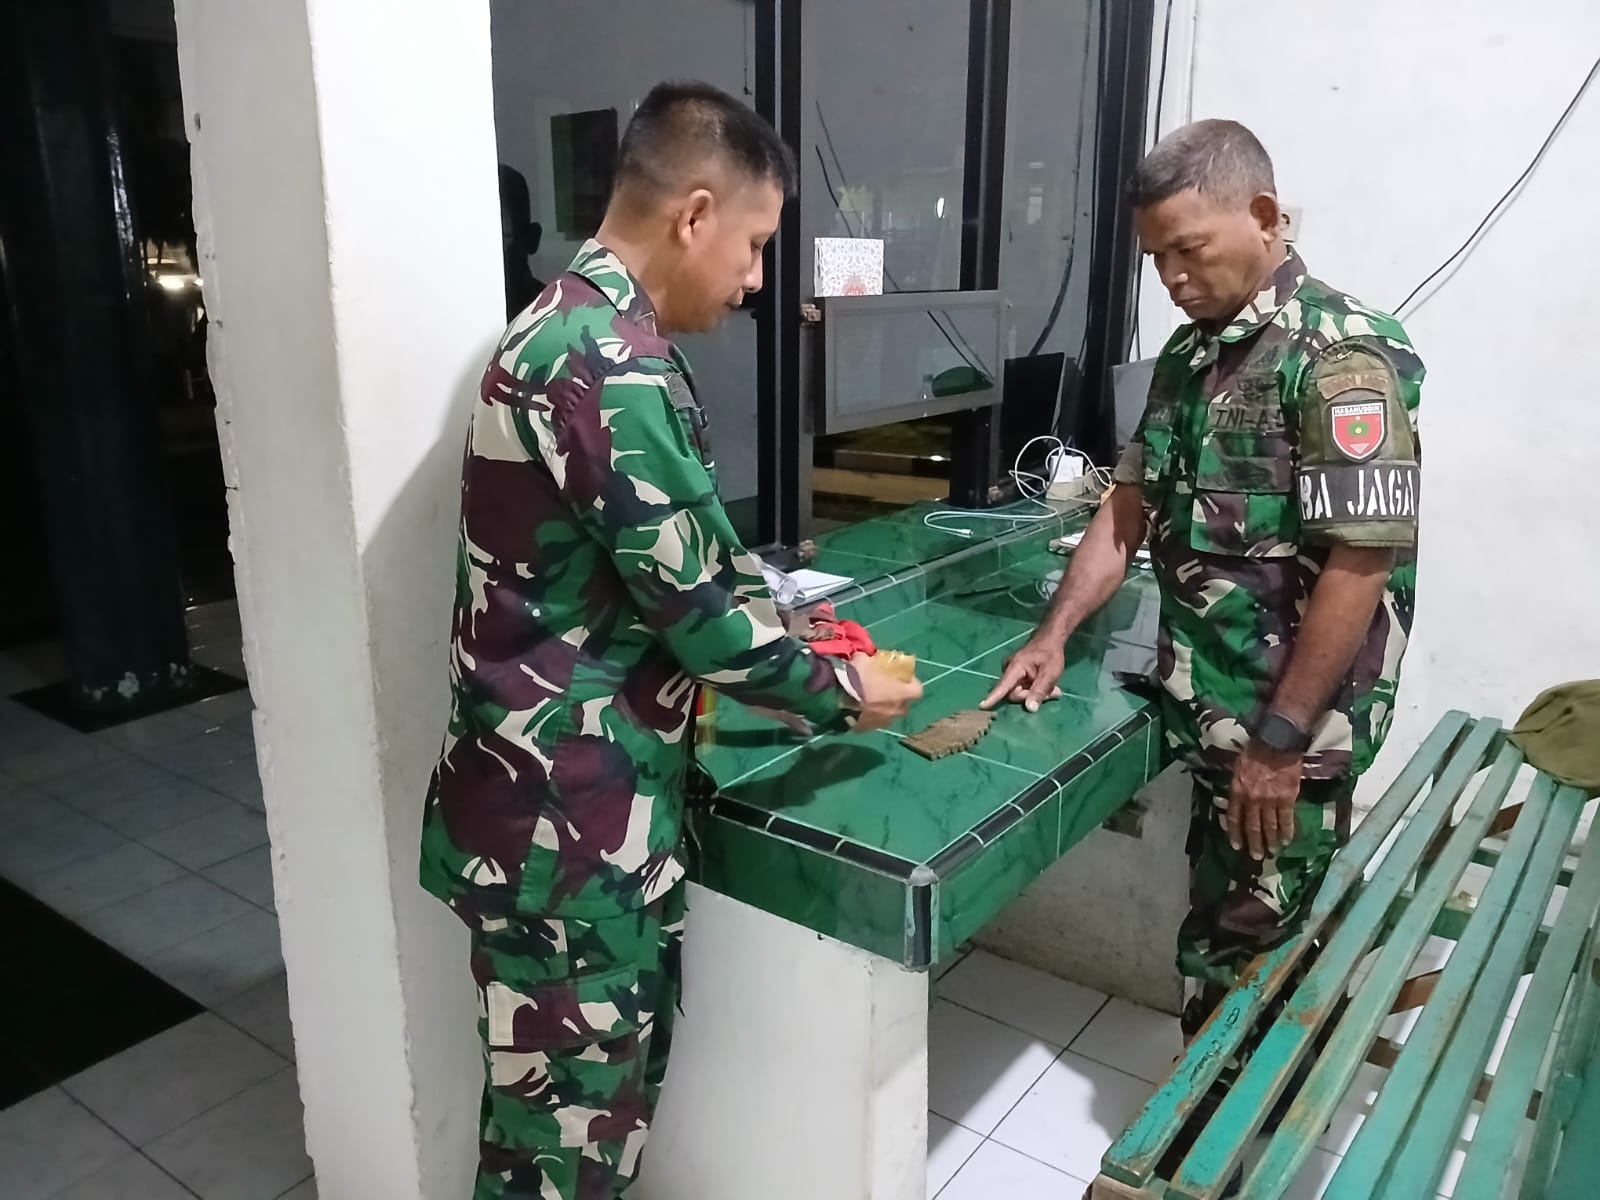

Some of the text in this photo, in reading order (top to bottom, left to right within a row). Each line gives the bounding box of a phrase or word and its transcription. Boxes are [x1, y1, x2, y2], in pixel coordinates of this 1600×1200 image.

[1333, 404, 1381, 416] HASANUDDIN
[1299, 468, 1415, 520] BA JAGA
